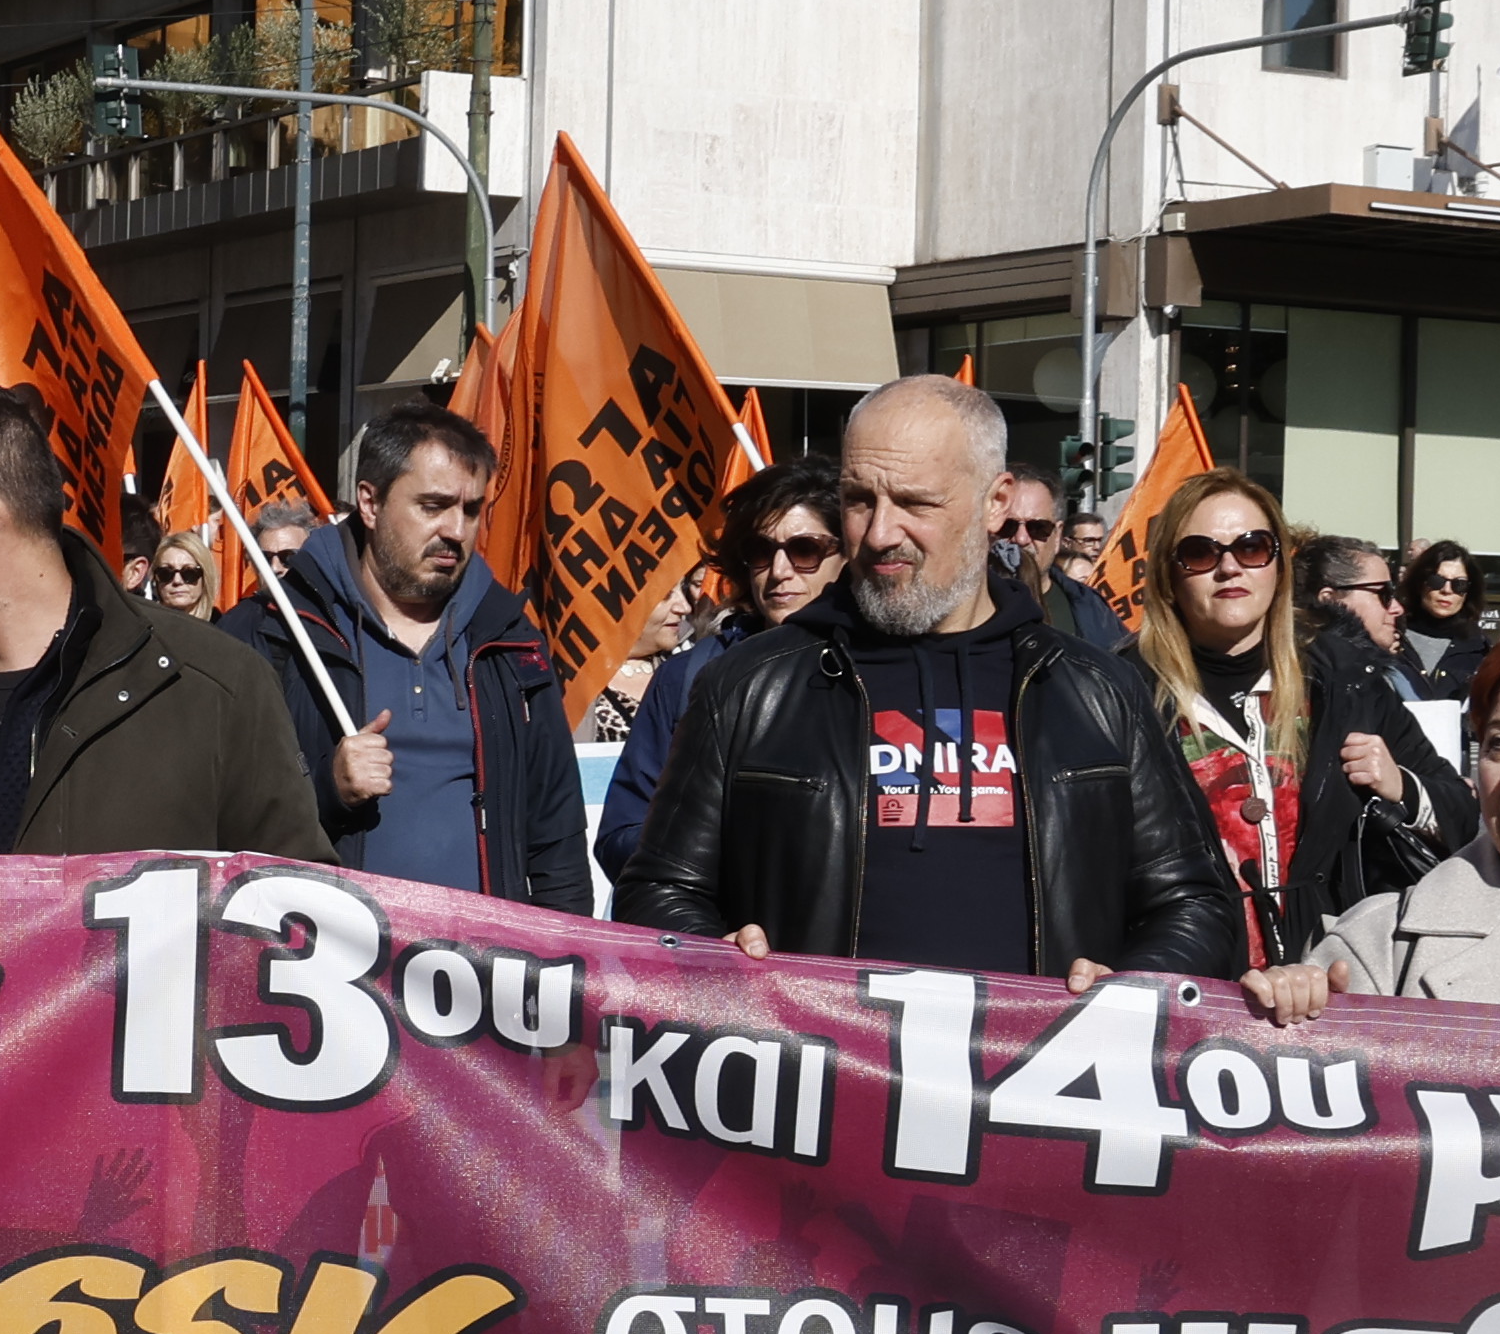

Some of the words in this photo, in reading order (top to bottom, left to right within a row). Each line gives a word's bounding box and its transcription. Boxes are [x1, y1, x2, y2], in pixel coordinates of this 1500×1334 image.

[882, 785, 912, 795] Your
[88, 865, 579, 1104] 13ου
[607, 1030, 829, 1158] και
[866, 970, 1366, 1188] 14ου
